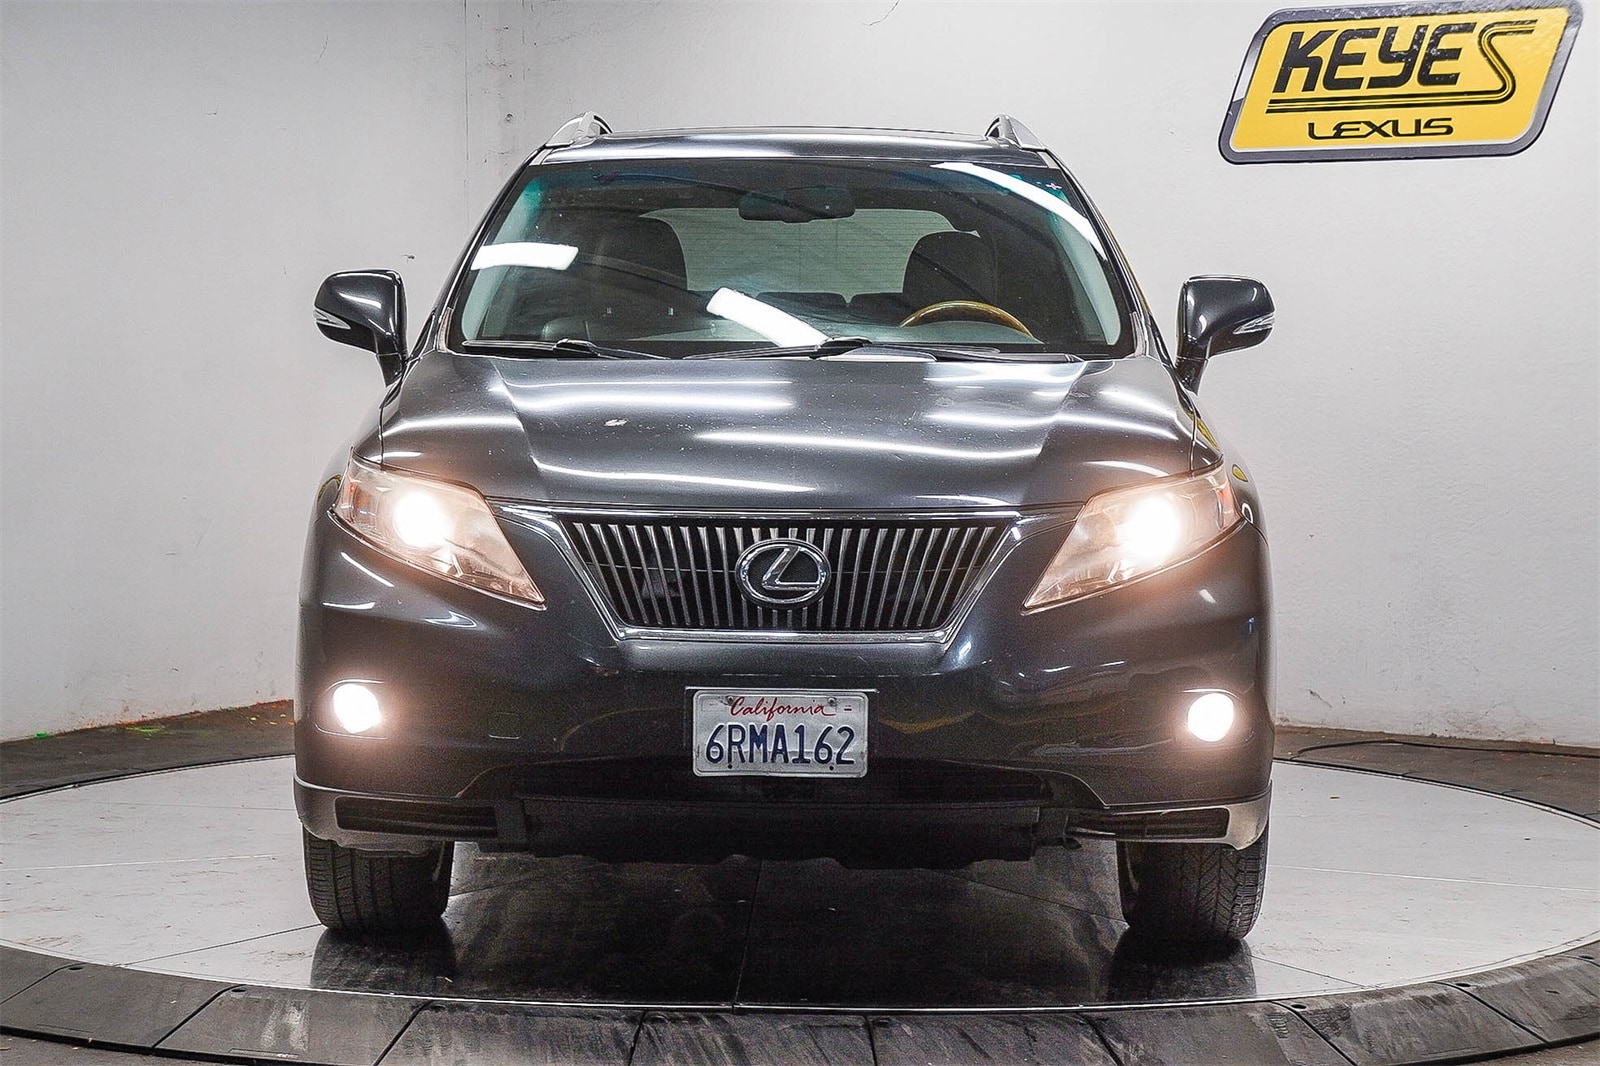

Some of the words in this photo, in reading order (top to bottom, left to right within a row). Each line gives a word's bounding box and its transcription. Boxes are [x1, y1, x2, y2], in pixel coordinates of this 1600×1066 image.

[1267, 19, 1538, 112] KEYES
[1308, 118, 1453, 140] LEXUS
[730, 696, 836, 722] California
[705, 723, 855, 766] 6RMA162
